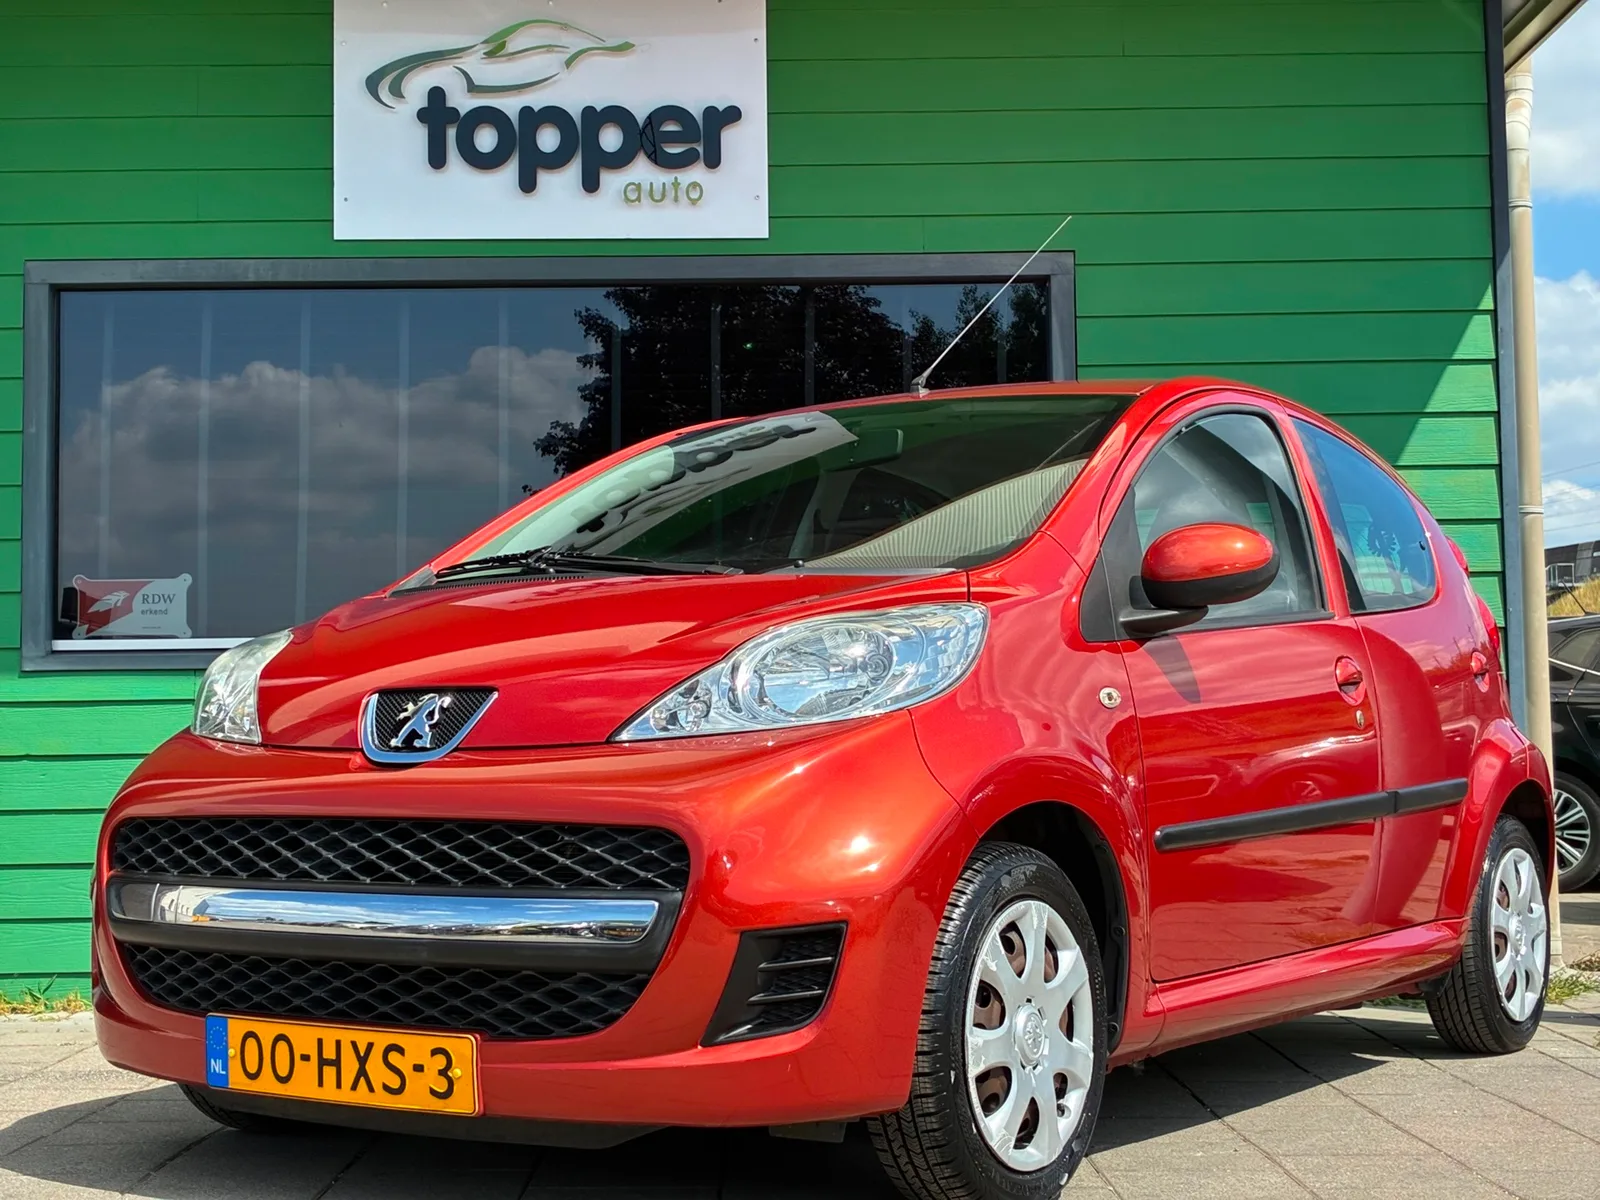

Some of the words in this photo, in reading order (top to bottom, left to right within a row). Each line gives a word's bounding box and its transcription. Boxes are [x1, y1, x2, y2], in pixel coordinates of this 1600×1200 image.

[416, 85, 743, 194] topper
[623, 176, 704, 205] auto
[141, 593, 176, 604] RDW
[210, 1058, 226, 1075] NL
[239, 1030, 455, 1100] 00-HXS-3
